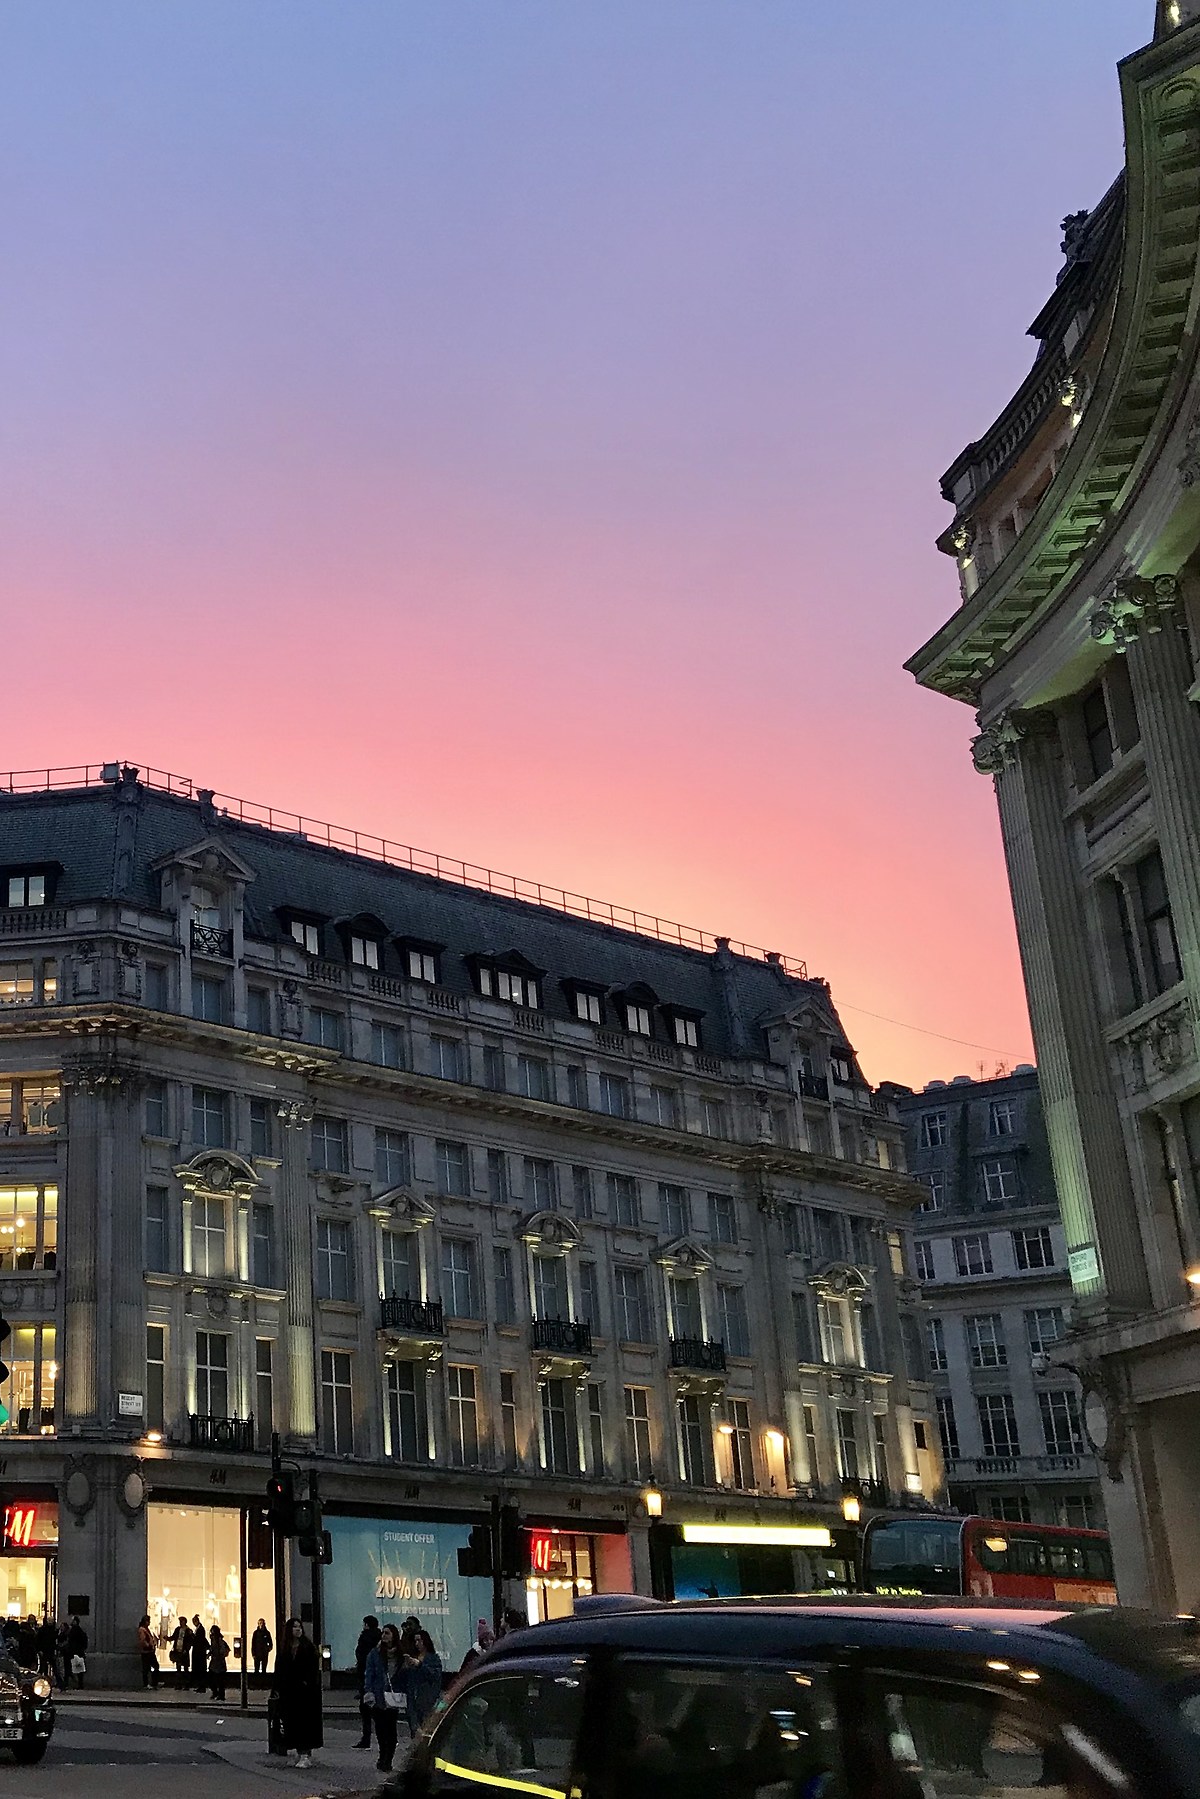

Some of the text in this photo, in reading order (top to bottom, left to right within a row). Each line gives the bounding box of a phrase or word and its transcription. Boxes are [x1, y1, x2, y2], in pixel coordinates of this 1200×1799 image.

[384, 1531, 435, 1544] STUDENT OFFER
[375, 1575, 449, 1601] 20% OFF!
